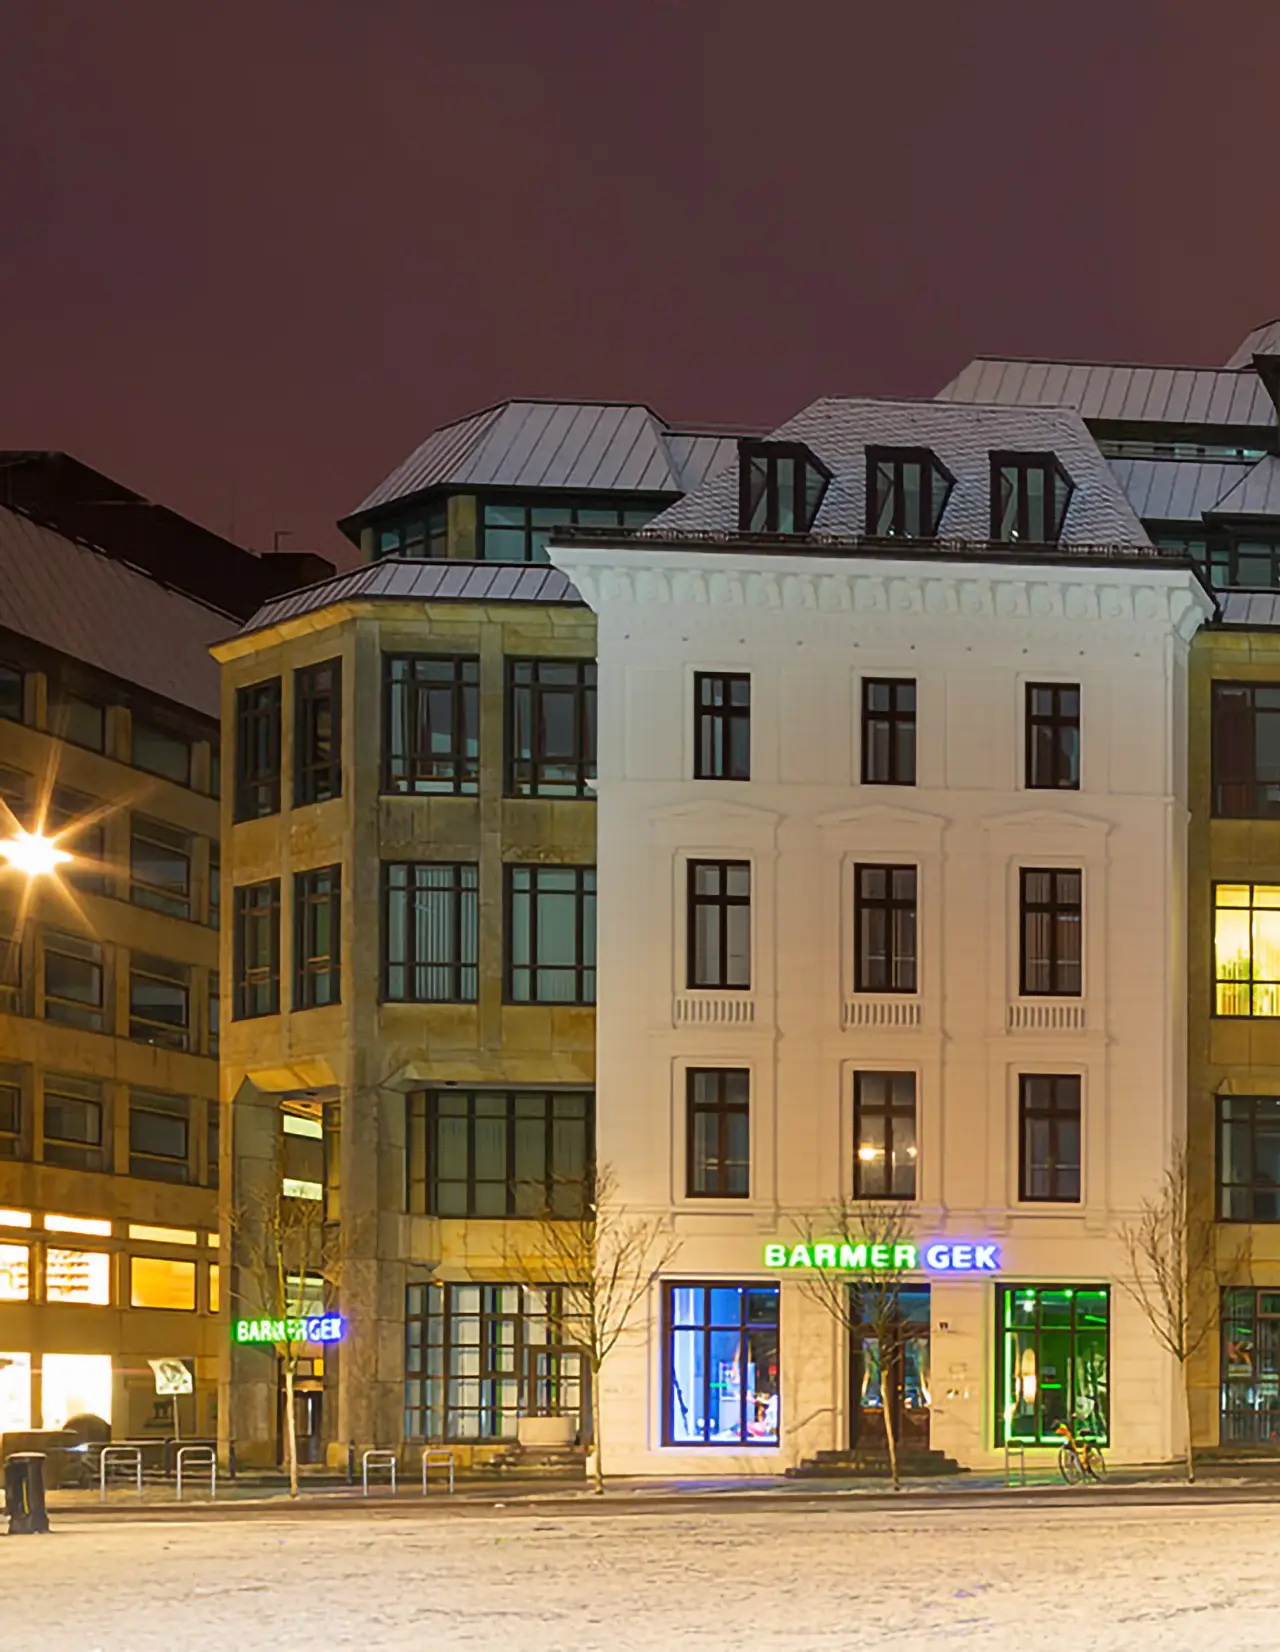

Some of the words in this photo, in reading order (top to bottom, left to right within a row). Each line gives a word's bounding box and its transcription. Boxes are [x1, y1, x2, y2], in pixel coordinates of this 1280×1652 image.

[765, 1243, 917, 1268] BARMER
[926, 1244, 998, 1269] GEK
[308, 1318, 342, 1341] GEK
